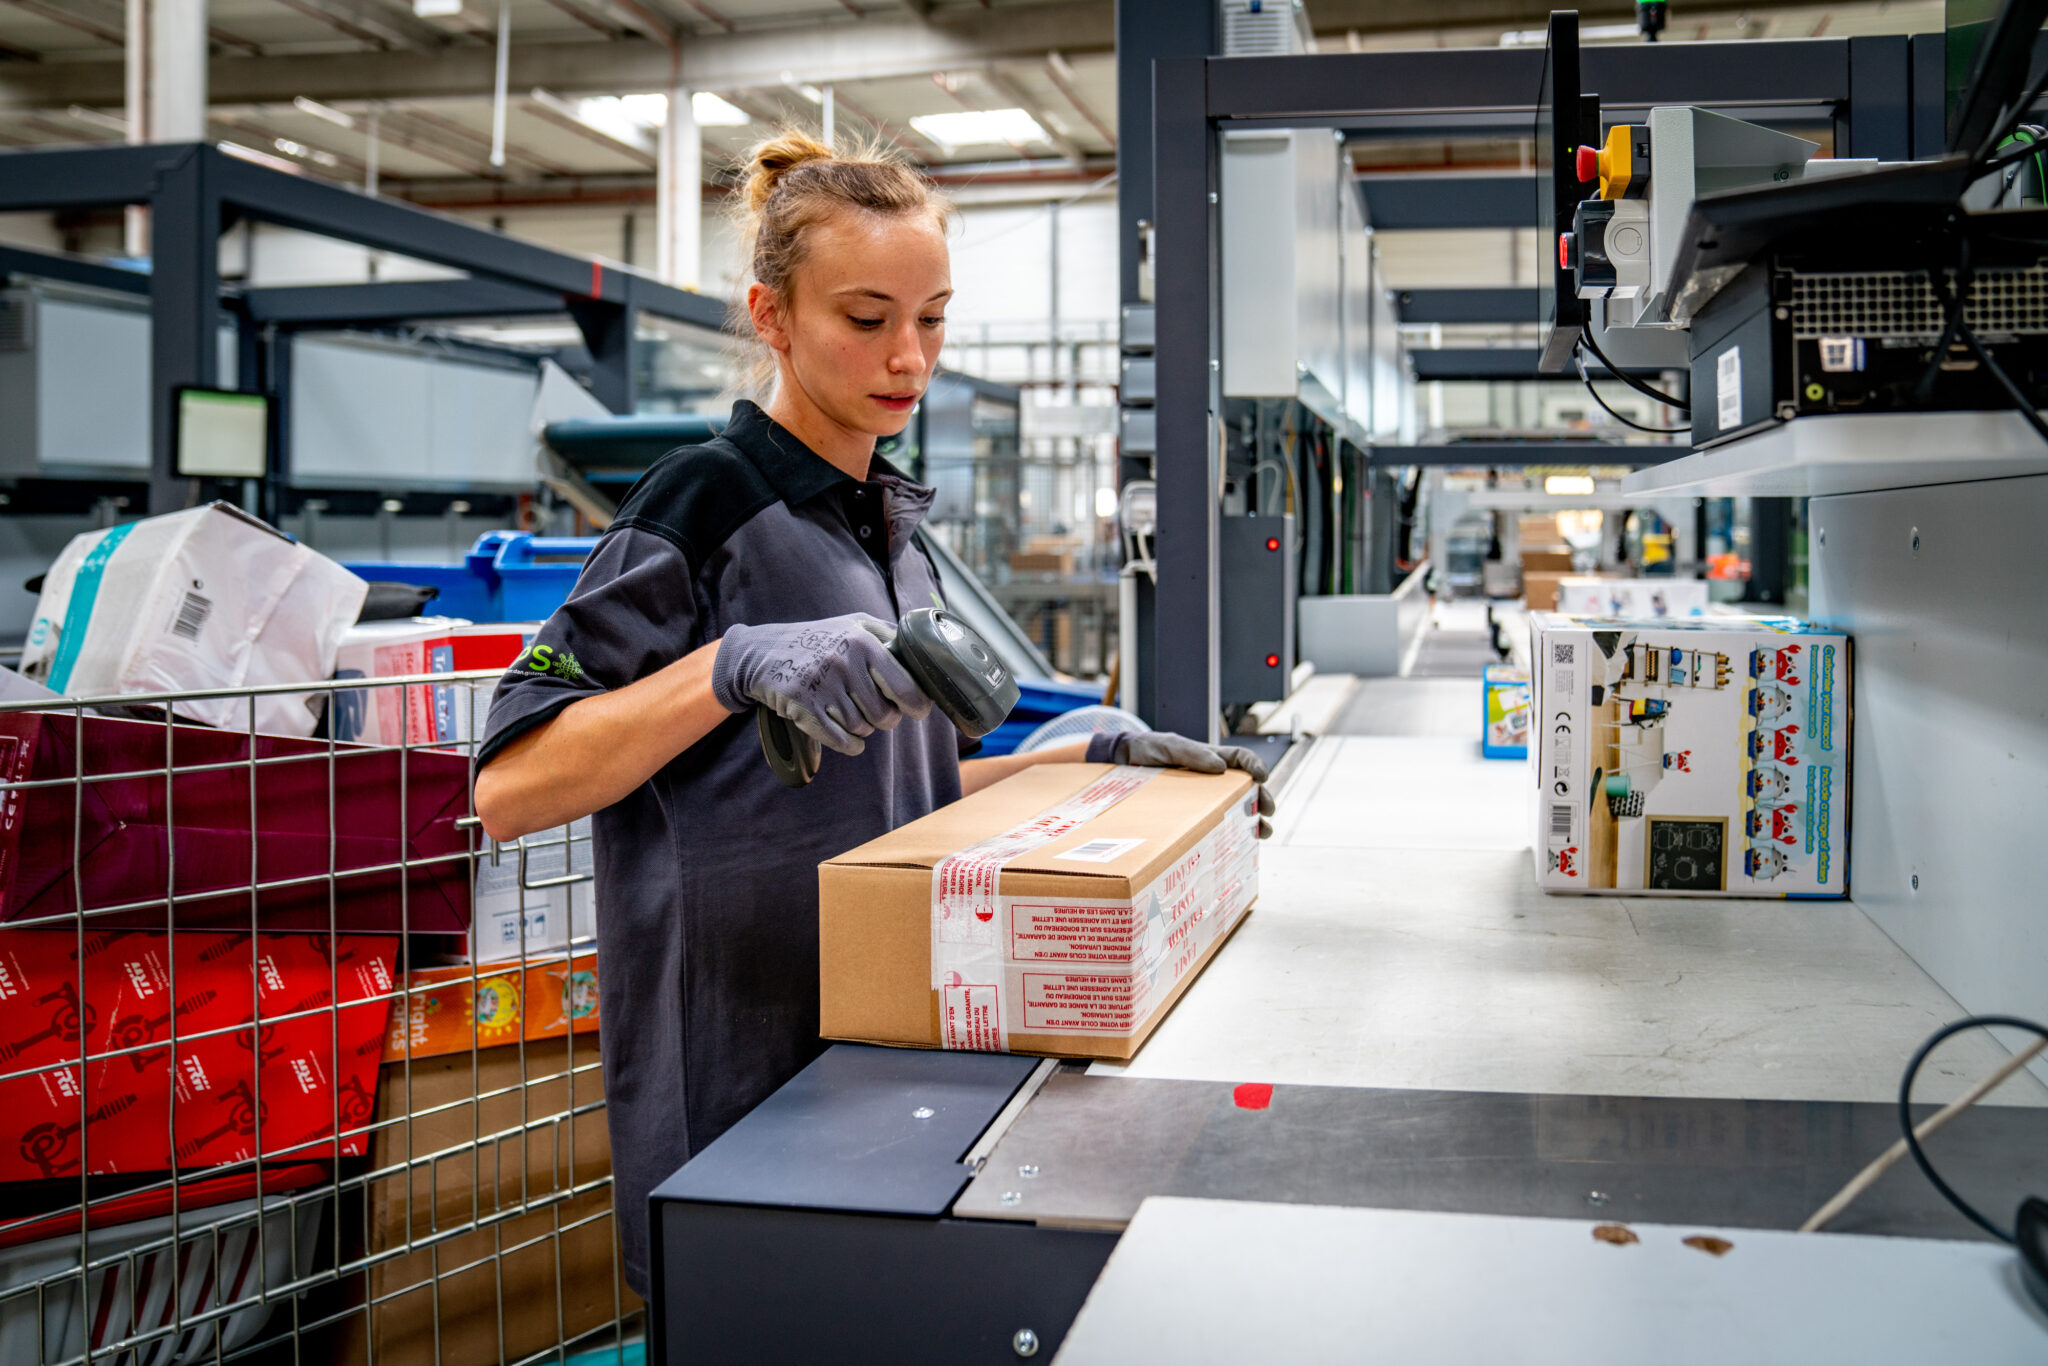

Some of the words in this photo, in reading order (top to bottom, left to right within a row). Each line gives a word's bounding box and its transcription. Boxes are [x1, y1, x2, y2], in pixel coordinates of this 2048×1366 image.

[1823, 646, 1834, 692] Customise
[1821, 694, 1832, 714] your
[1822, 716, 1832, 749] mascot
[1821, 768, 1831, 800] Include
[1819, 811, 1828, 838] range
[1820, 840, 1829, 849] of
[1818, 851, 1828, 882] stickers
[124, 962, 154, 999] TRW
[258, 955, 285, 991] TRW
[369, 957, 393, 990] TRW
[966, 1020, 971, 1028] DE
[183, 1055, 211, 1091] TRW
[290, 1058, 317, 1093] TRW
